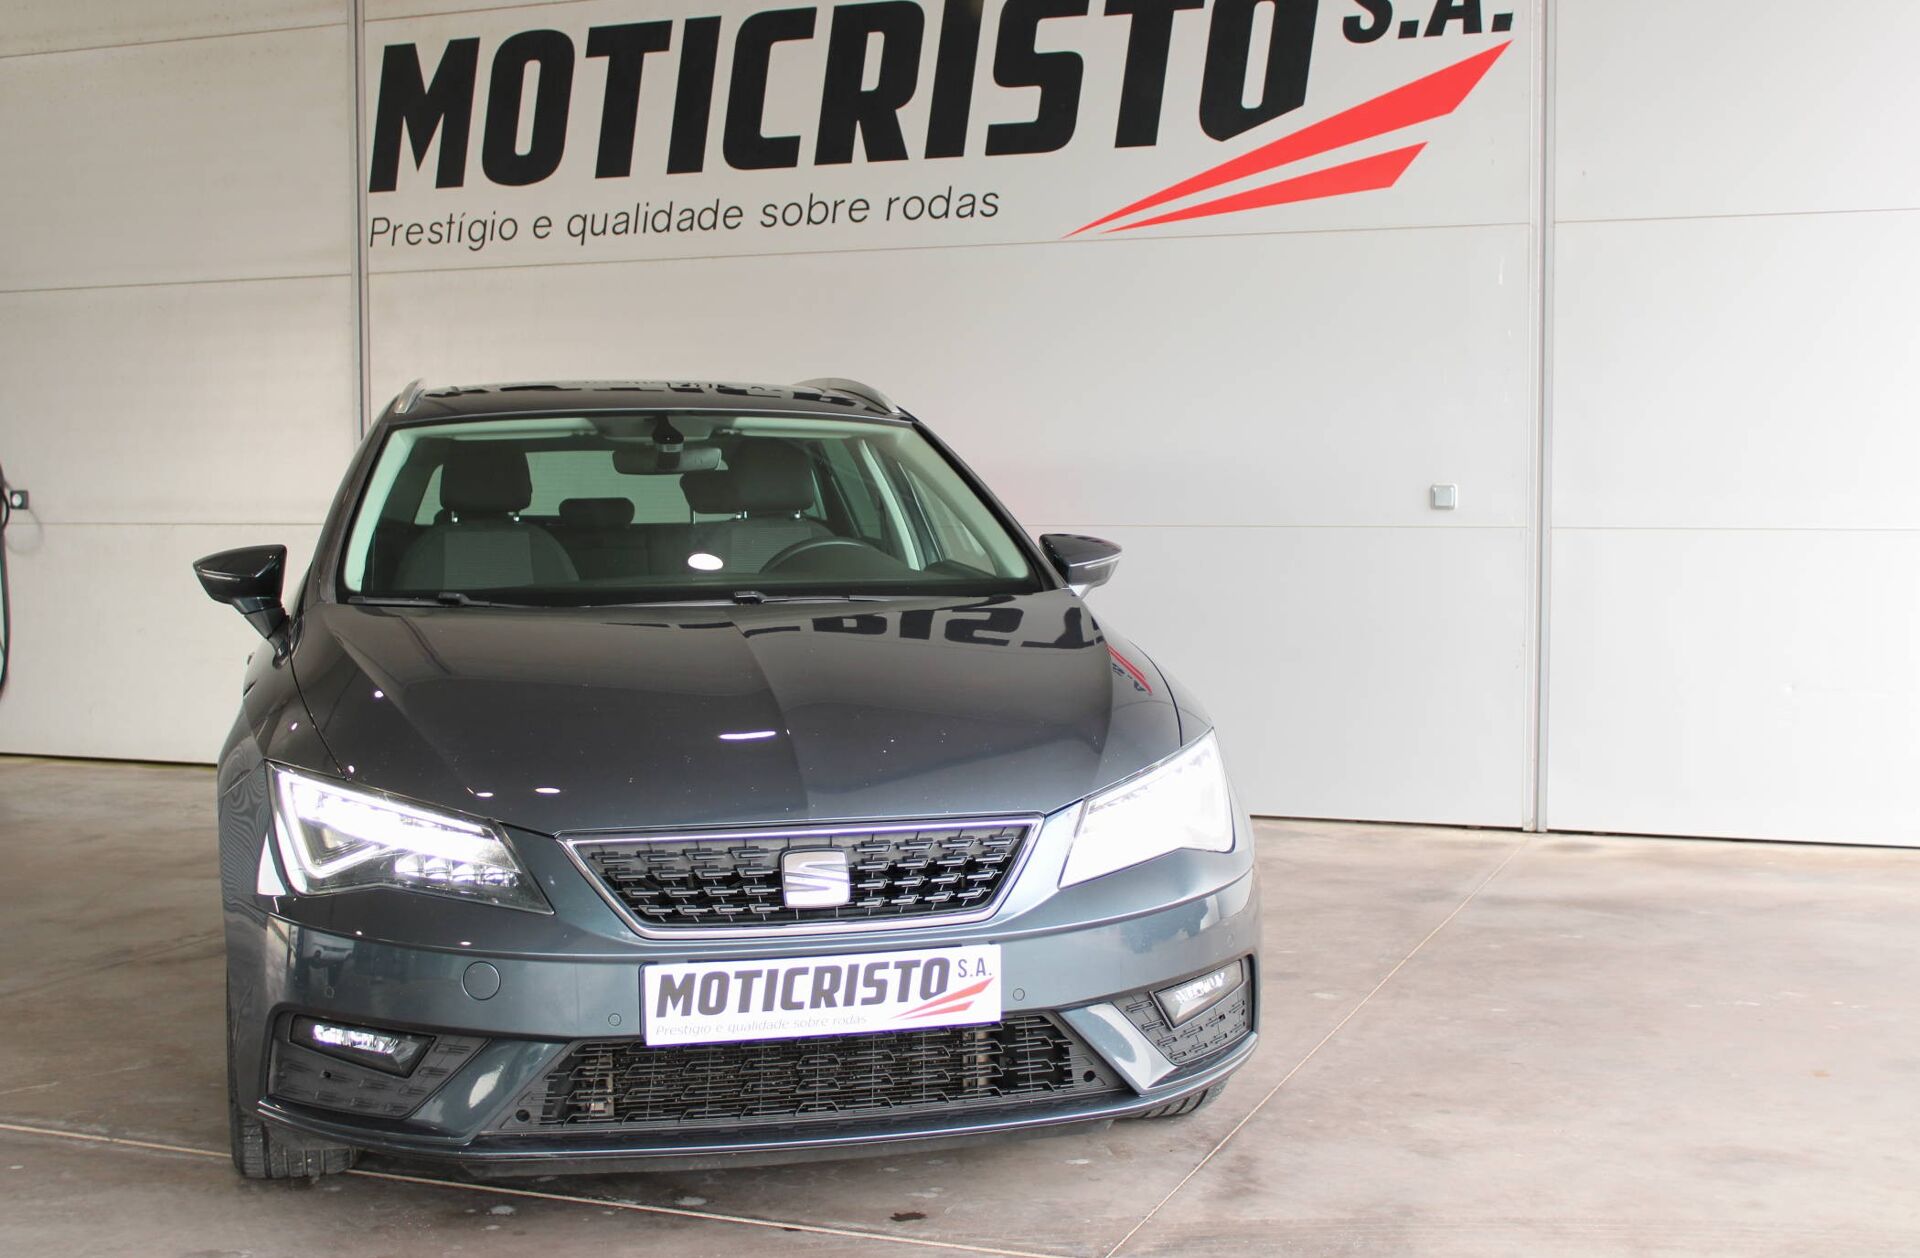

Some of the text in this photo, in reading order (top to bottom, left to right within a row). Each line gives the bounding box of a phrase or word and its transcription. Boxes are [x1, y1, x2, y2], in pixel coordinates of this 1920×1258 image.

[369, 0, 1318, 193] MOTICRISTO
[370, 186, 1000, 251] Prestígio e qualidade sobre rodas
[656, 957, 994, 1018] MOTICRISTO S.A.
